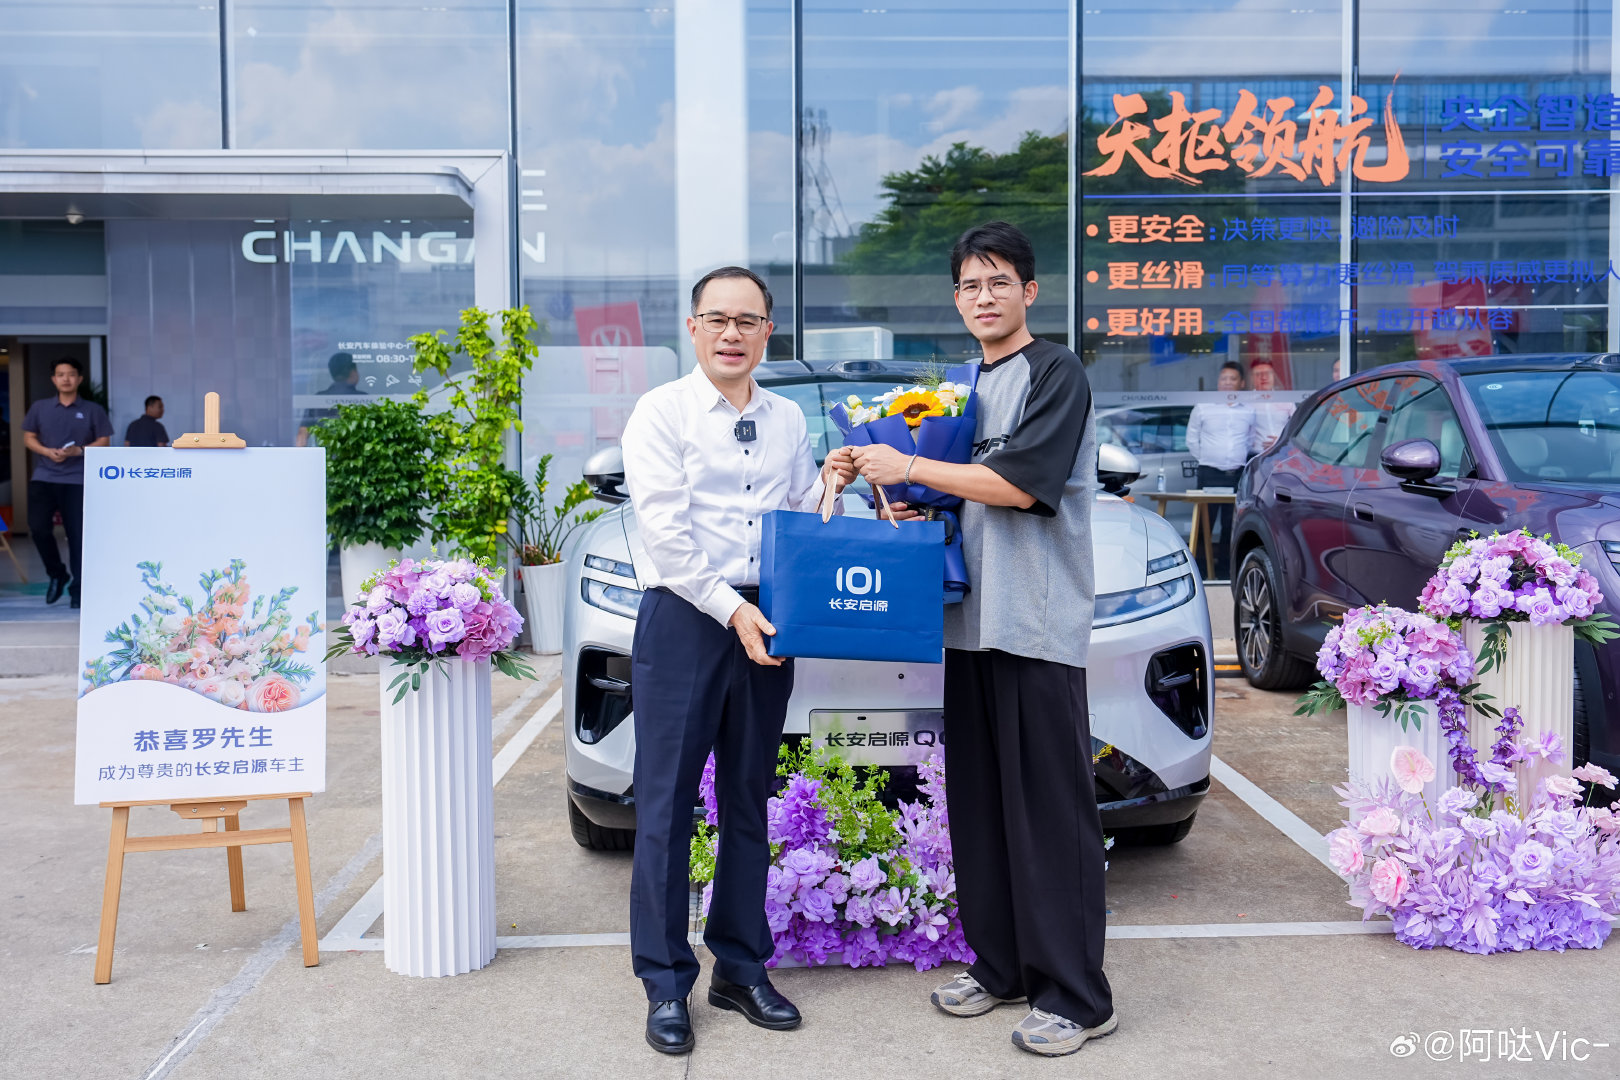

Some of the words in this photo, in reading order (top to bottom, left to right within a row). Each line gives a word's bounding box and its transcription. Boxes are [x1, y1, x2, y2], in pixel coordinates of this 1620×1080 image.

[1441, 92, 1620, 132] 央企智造
[1083, 74, 1410, 187] 天枢领航
[1441, 138, 1620, 179] 安全可靠
[241, 230, 546, 264] CHANGN
[127, 467, 193, 479] 长安启源
[828, 597, 889, 612] 长安启源
[133, 725, 274, 753] 恭喜罗先生
[98, 756, 306, 782] 成为尊贵的长安启源车主
